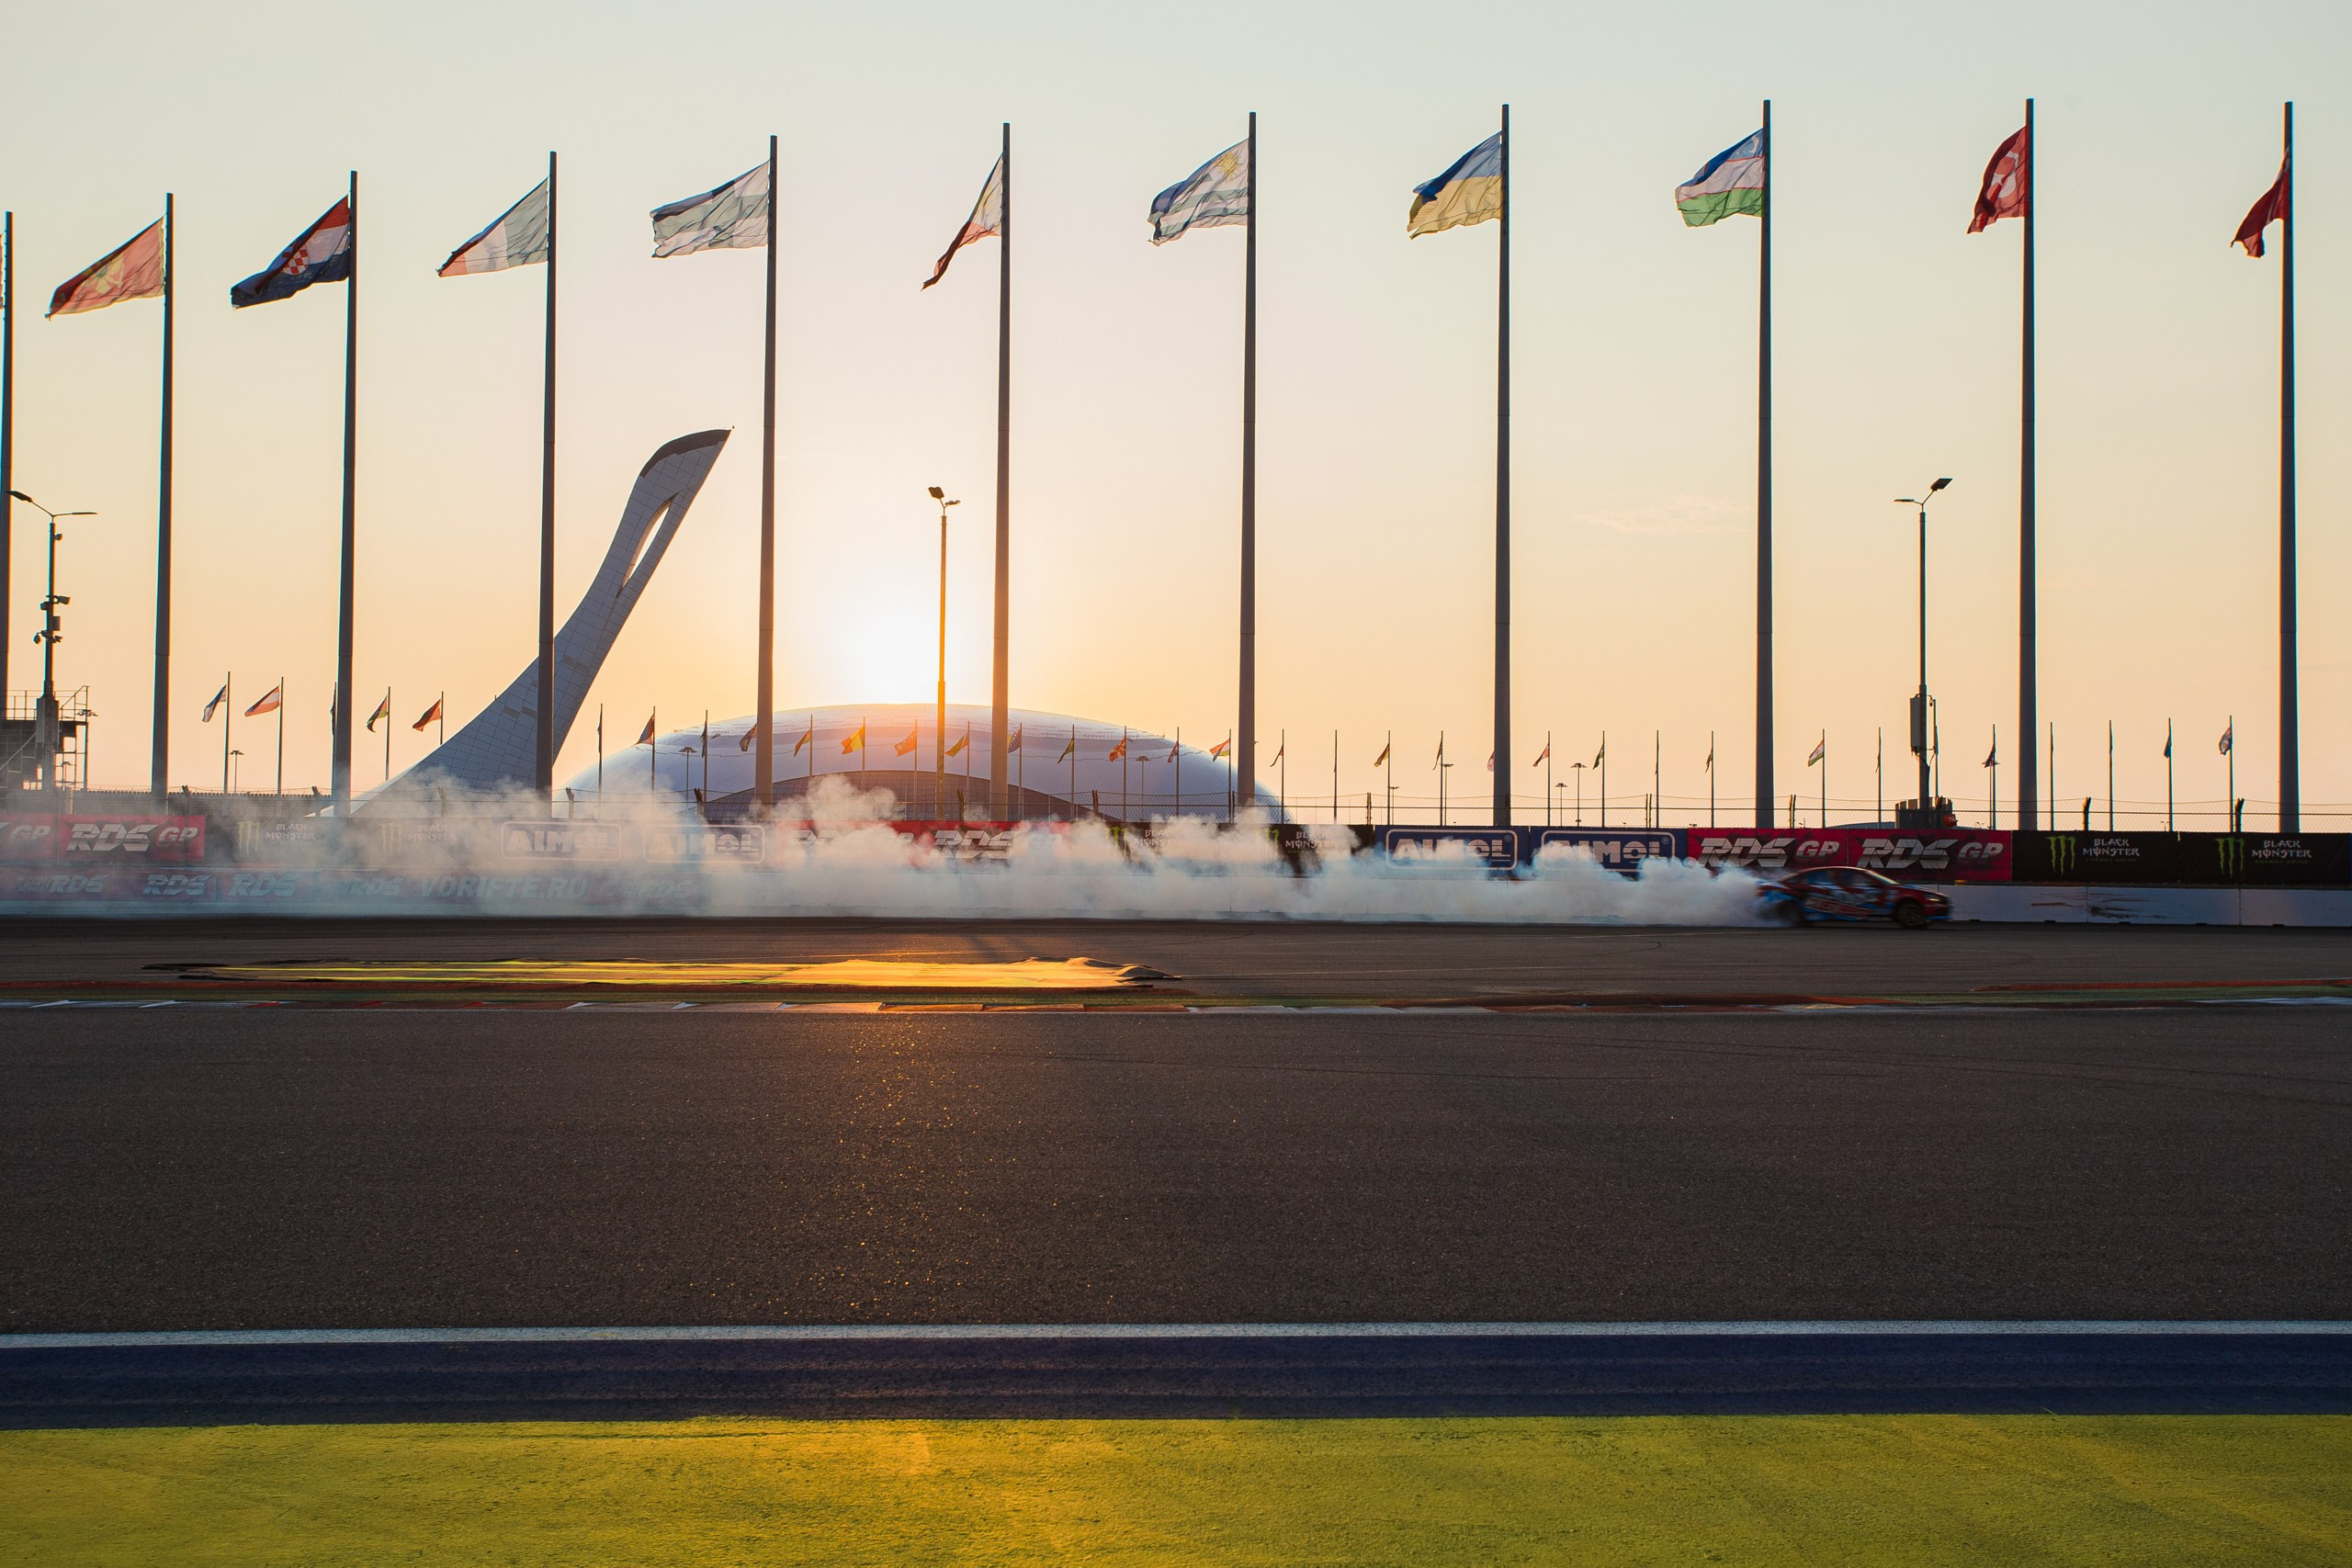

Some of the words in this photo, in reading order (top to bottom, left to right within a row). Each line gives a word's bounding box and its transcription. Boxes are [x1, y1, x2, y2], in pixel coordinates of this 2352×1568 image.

[66, 823, 159, 852] RDS
[157, 826, 198, 845] GP
[648, 833, 760, 856] AIMOL
[930, 829, 1023, 859] RDS
[2094, 838, 2130, 847] BLACK
[2263, 840, 2301, 849] BLACK
[1391, 838, 1511, 862] AIMOL
[1700, 837, 1797, 868] RDS
[1795, 840, 1840, 861] GP
[1856, 838, 1959, 870] RDS
[1958, 842, 2004, 863] GP
[2082, 846, 2141, 857] MONSTER
[2251, 848, 2312, 859] MONSTER
[49, 874, 109, 894] RDS
[142, 874, 212, 896] RDS
[228, 874, 302, 897] RDS
